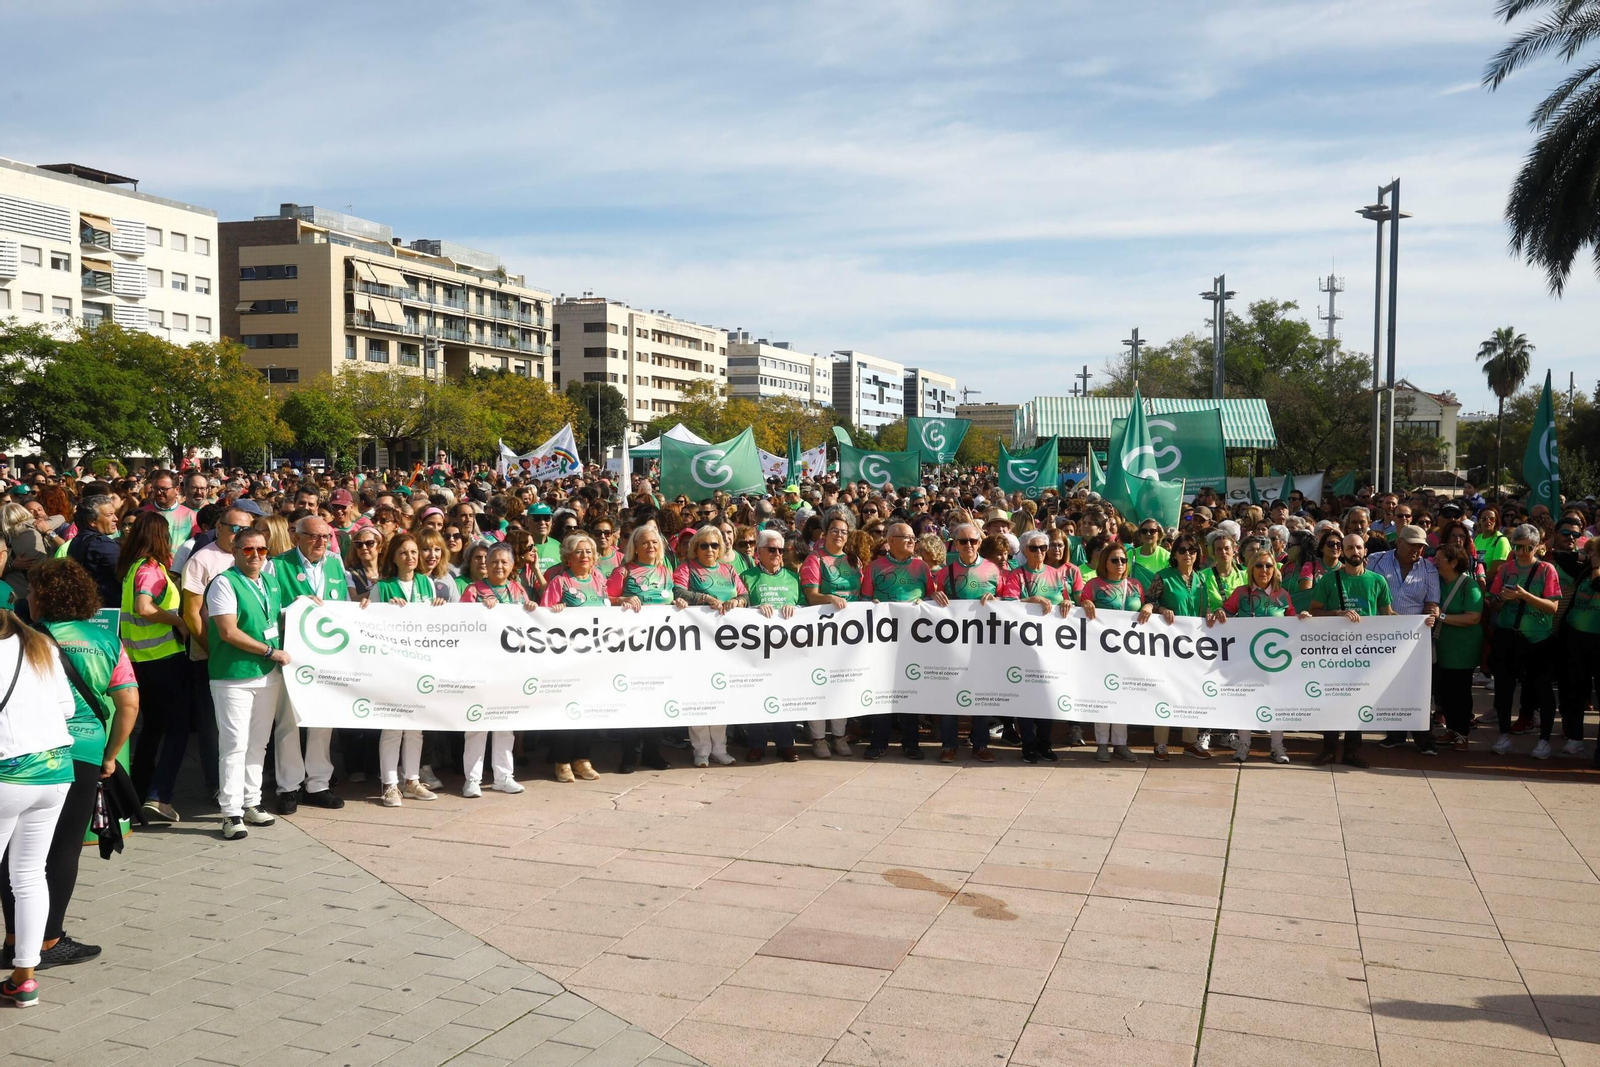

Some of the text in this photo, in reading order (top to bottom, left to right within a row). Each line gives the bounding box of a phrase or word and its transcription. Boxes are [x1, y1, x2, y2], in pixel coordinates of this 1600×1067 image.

[354, 620, 487, 635] asociación española
[400, 636, 411, 647] el
[415, 637, 460, 648] cáncer
[500, 610, 1236, 662] asociación española contra el cáncer
[1300, 630, 1420, 643] asociación española
[359, 643, 376, 654] en
[1300, 645, 1397, 655] contra el cáncer
[1318, 658, 1370, 668] Córdoba
